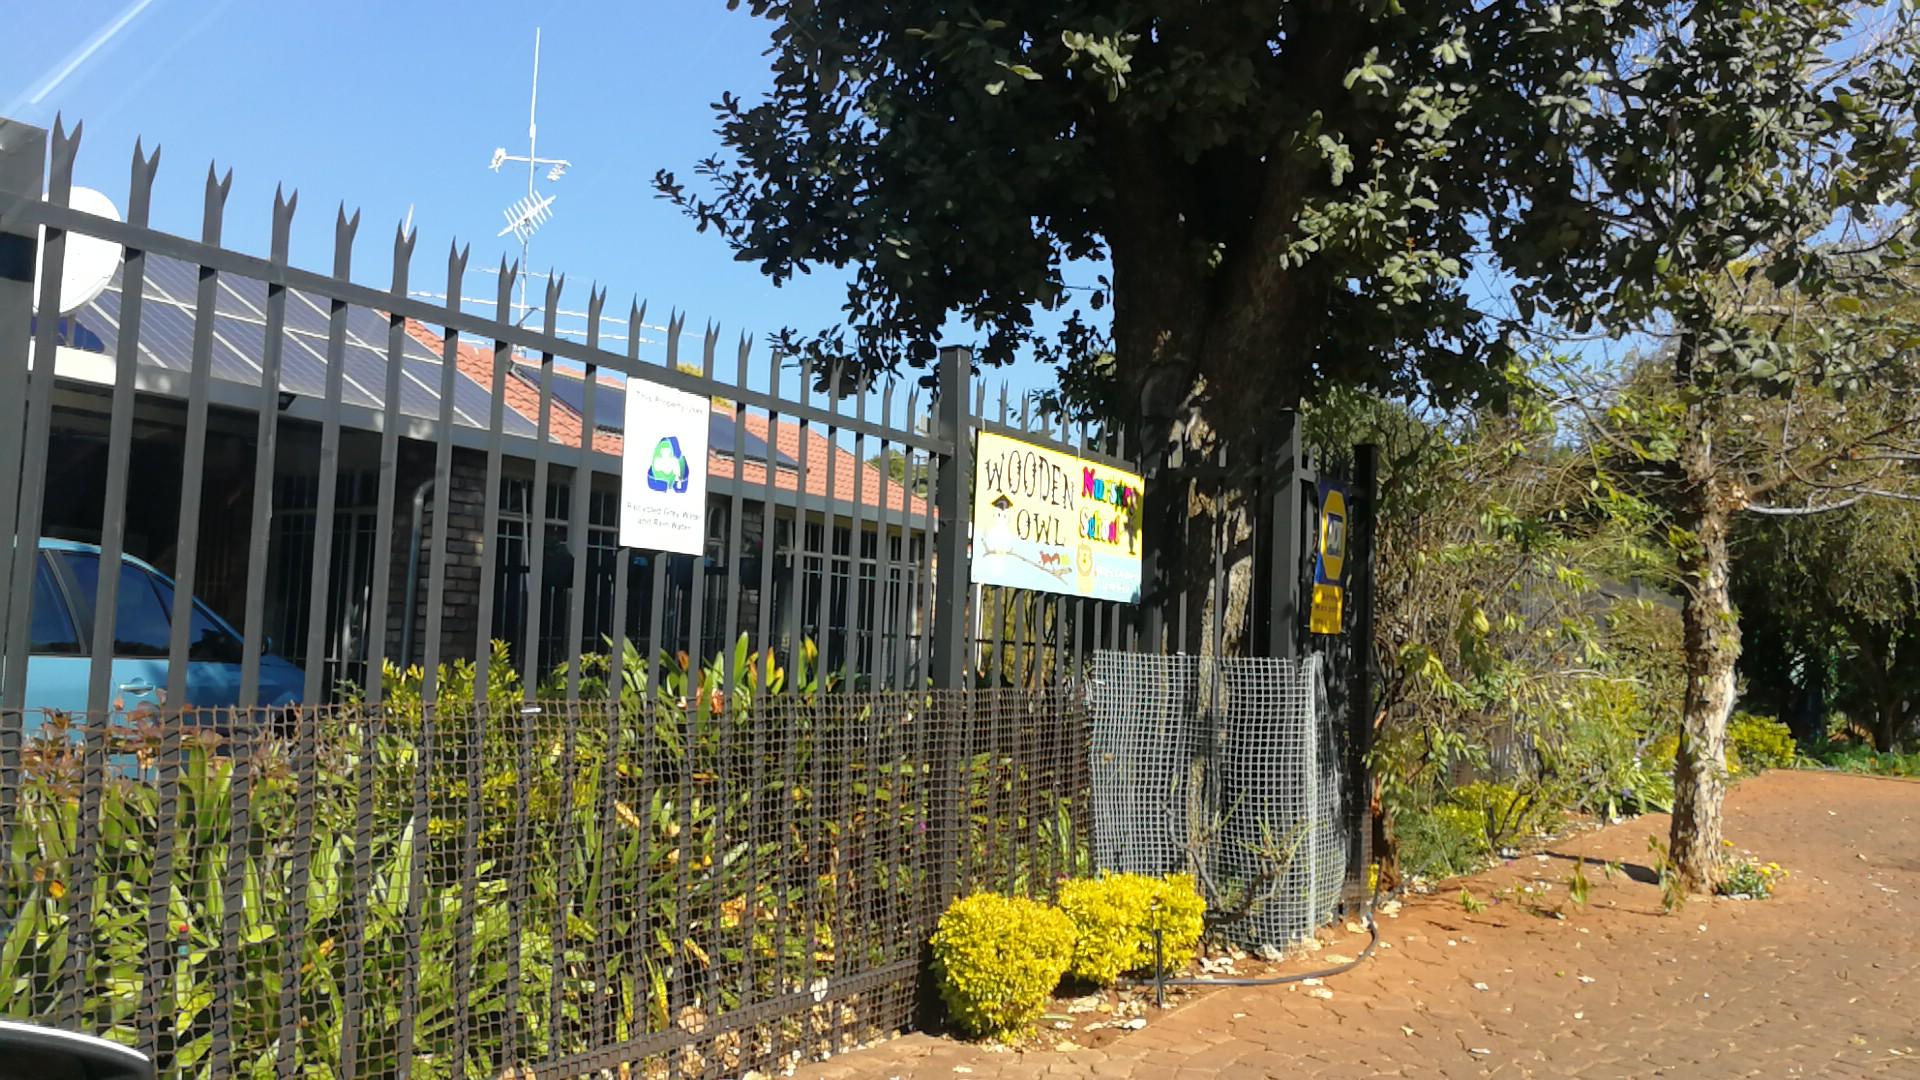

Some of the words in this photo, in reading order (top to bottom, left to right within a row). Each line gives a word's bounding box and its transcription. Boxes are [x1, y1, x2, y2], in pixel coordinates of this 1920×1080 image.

[985, 450, 1075, 511] WOODEN
[1016, 508, 1065, 547] OWL
[1079, 506, 1120, 545] School
